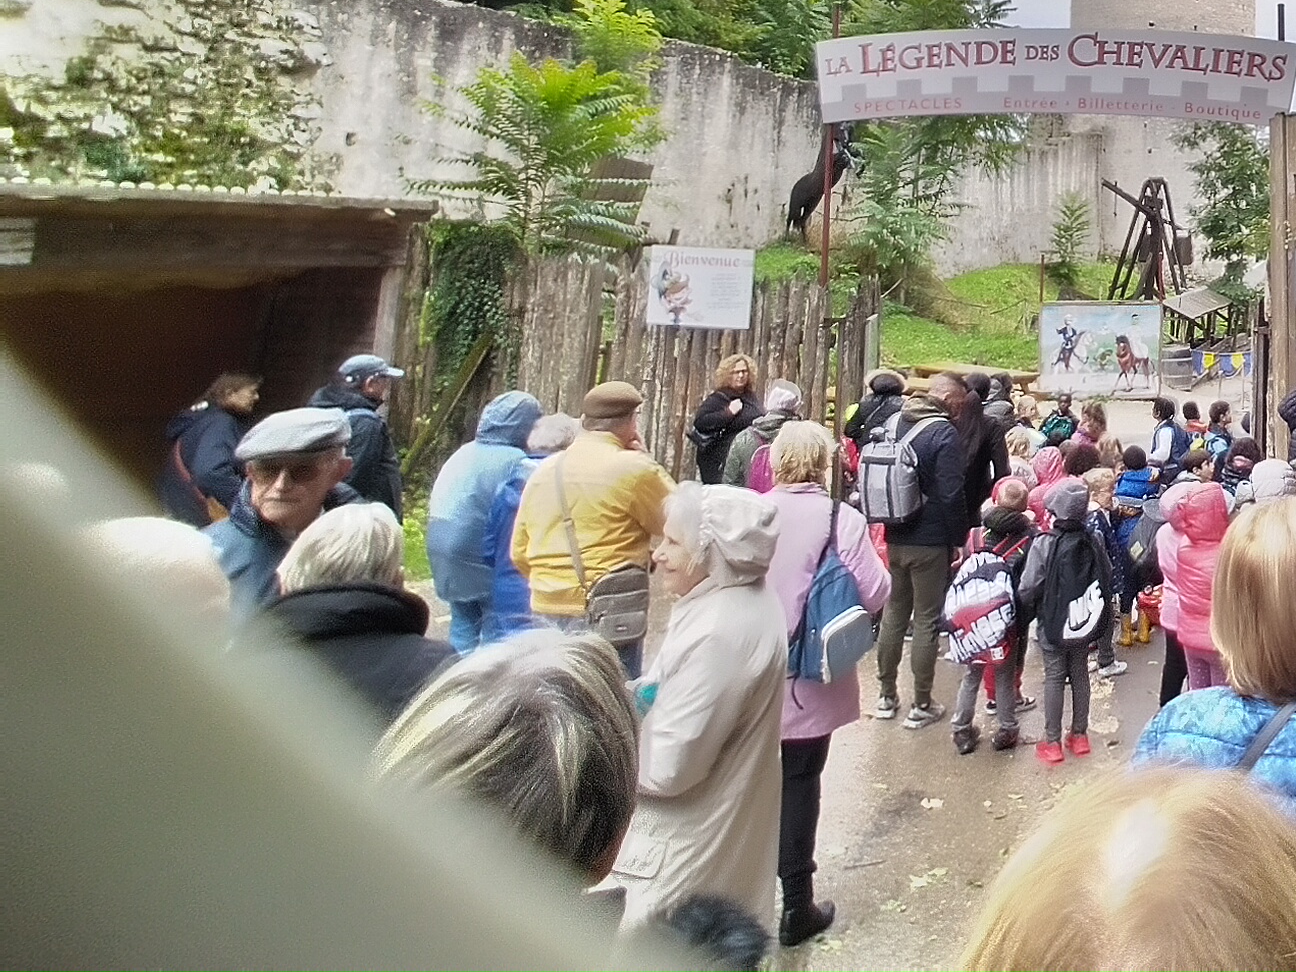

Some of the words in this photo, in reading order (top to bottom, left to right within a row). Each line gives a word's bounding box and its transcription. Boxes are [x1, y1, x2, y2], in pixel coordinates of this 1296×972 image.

[825, 58, 852, 77] LA
[858, 38, 1017, 77] LÉGENDE
[1025, 44, 1060, 62] DES
[1067, 31, 1288, 82] CHEVALIERS
[854, 97, 963, 114] SPECTACLES
[1003, 95, 1058, 109] Entrée
[1078, 97, 1163, 113] Billetterie
[1184, 101, 1261, 120] Boutique
[664, 250, 741, 268] Bienvenue
